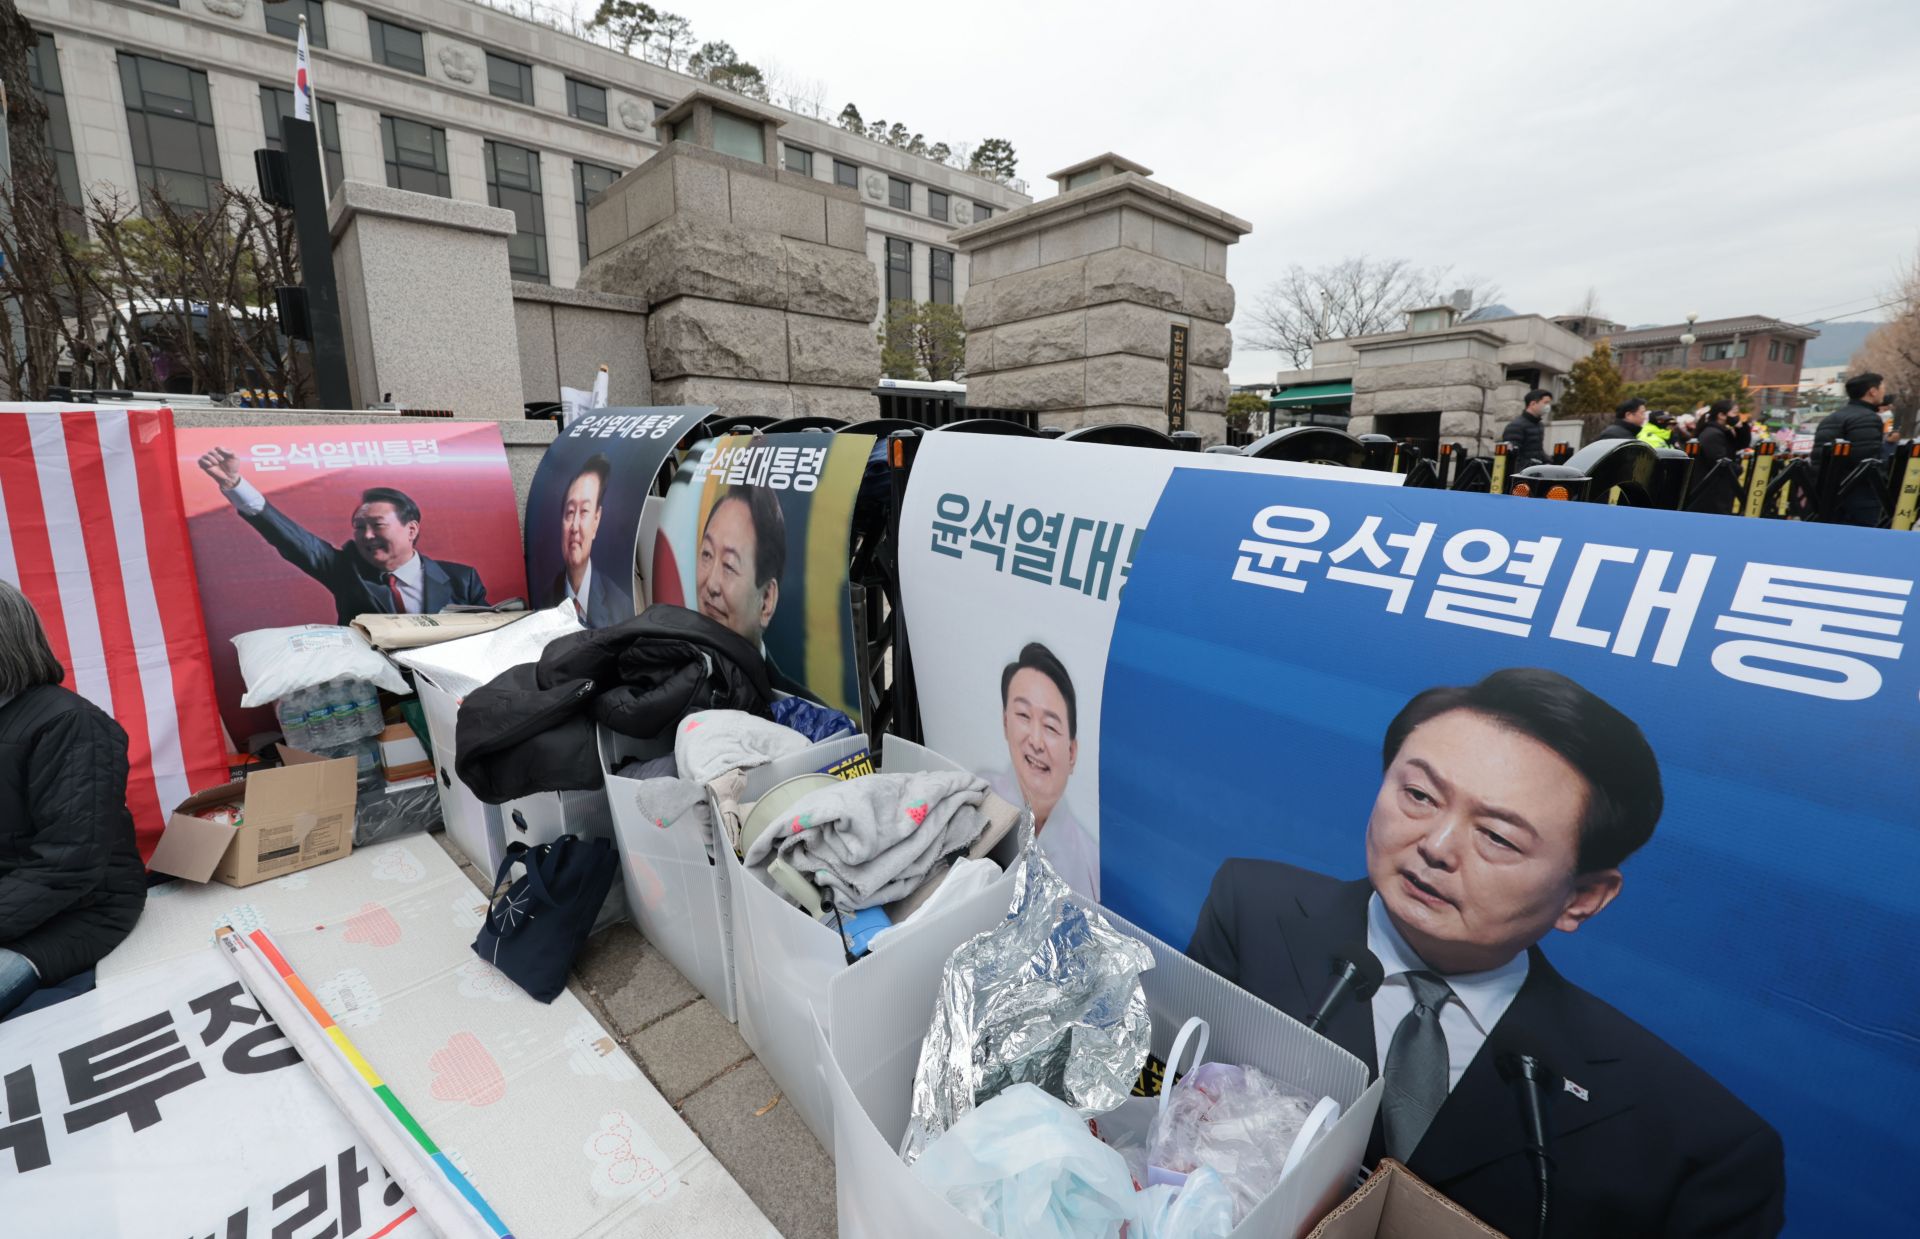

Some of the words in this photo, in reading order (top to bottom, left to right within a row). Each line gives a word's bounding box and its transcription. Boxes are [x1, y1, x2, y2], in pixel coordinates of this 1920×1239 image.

[1171, 331, 1185, 434] 헌법재판소사무
[251, 439, 440, 471] 윤석열대통령
[568, 414, 685, 439] 윤석열대통령
[691, 446, 828, 492] 윤석열대통령
[931, 492, 1146, 601] 윤석열대
[1231, 505, 1914, 700] 윤석열대통
